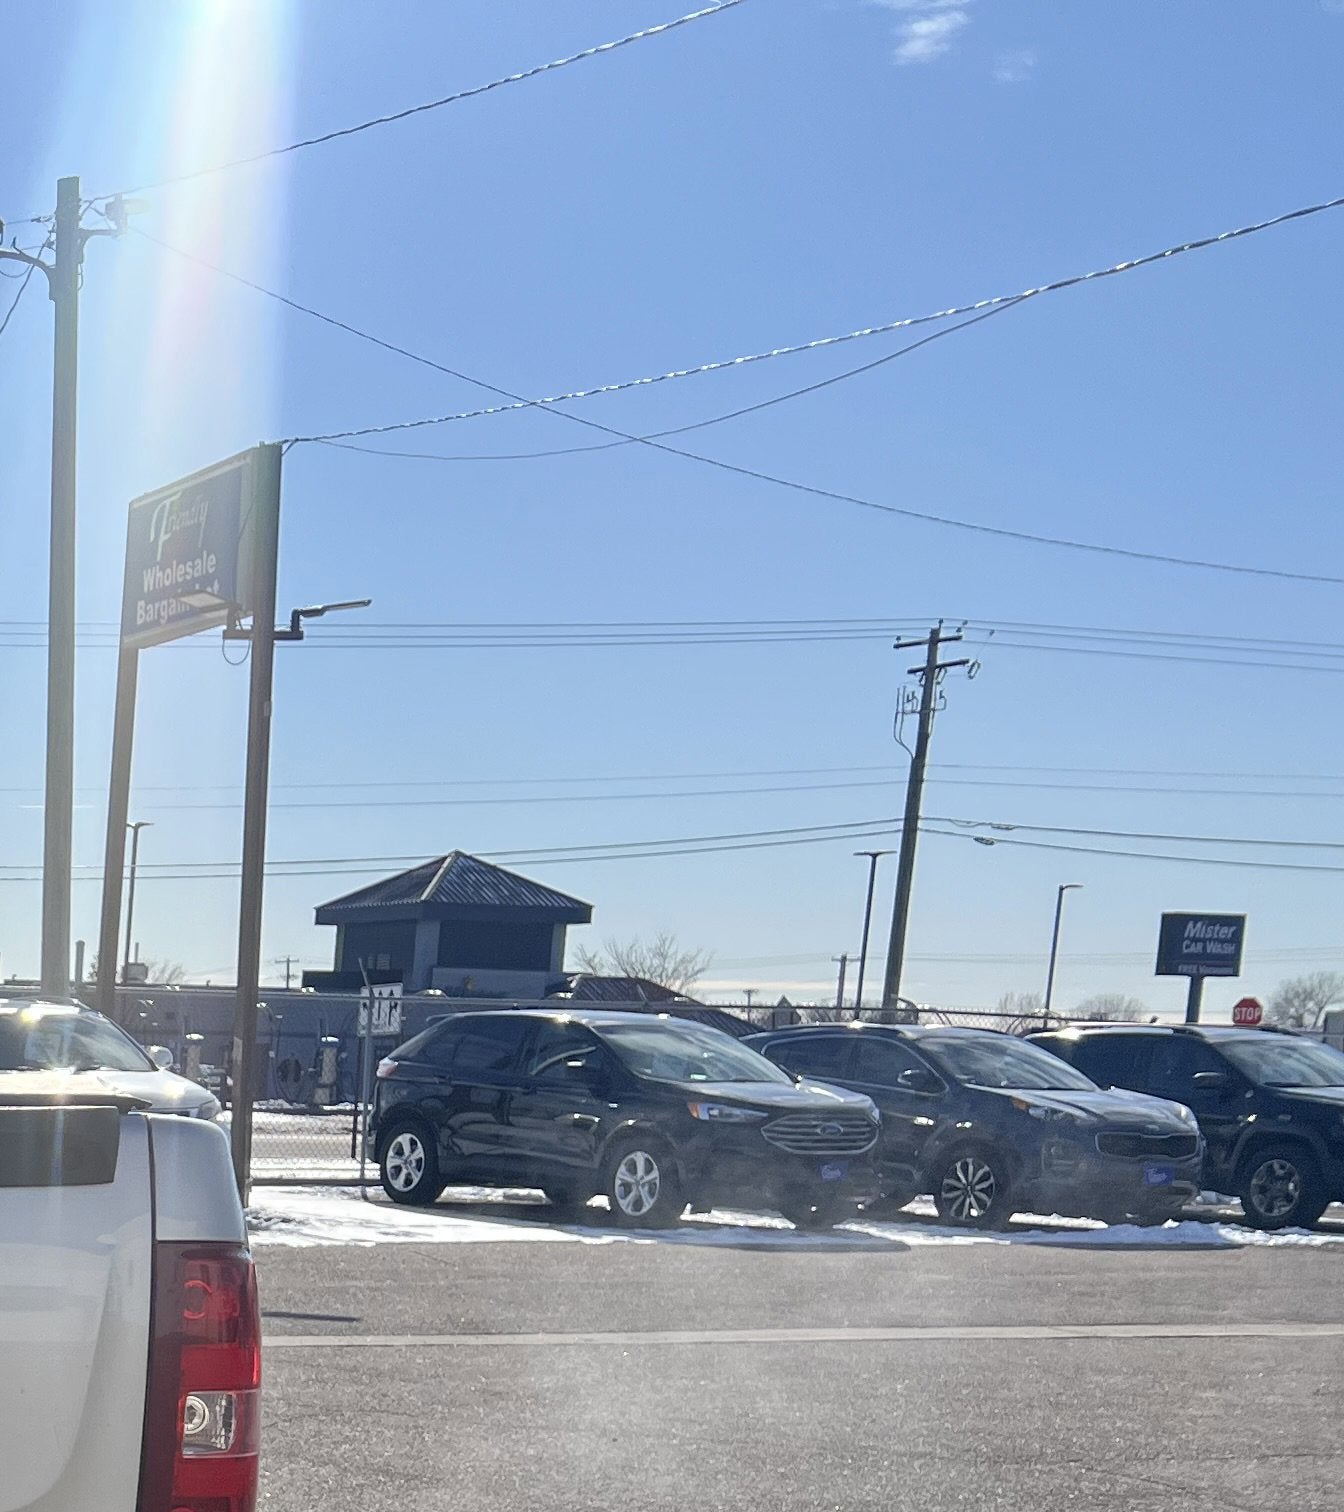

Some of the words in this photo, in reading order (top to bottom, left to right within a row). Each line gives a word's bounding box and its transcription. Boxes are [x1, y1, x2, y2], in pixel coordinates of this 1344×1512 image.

[143, 550, 217, 593] Wholesale
[1184, 920, 1237, 939] Mister
[1234, 1006, 1261, 1021] STOP
